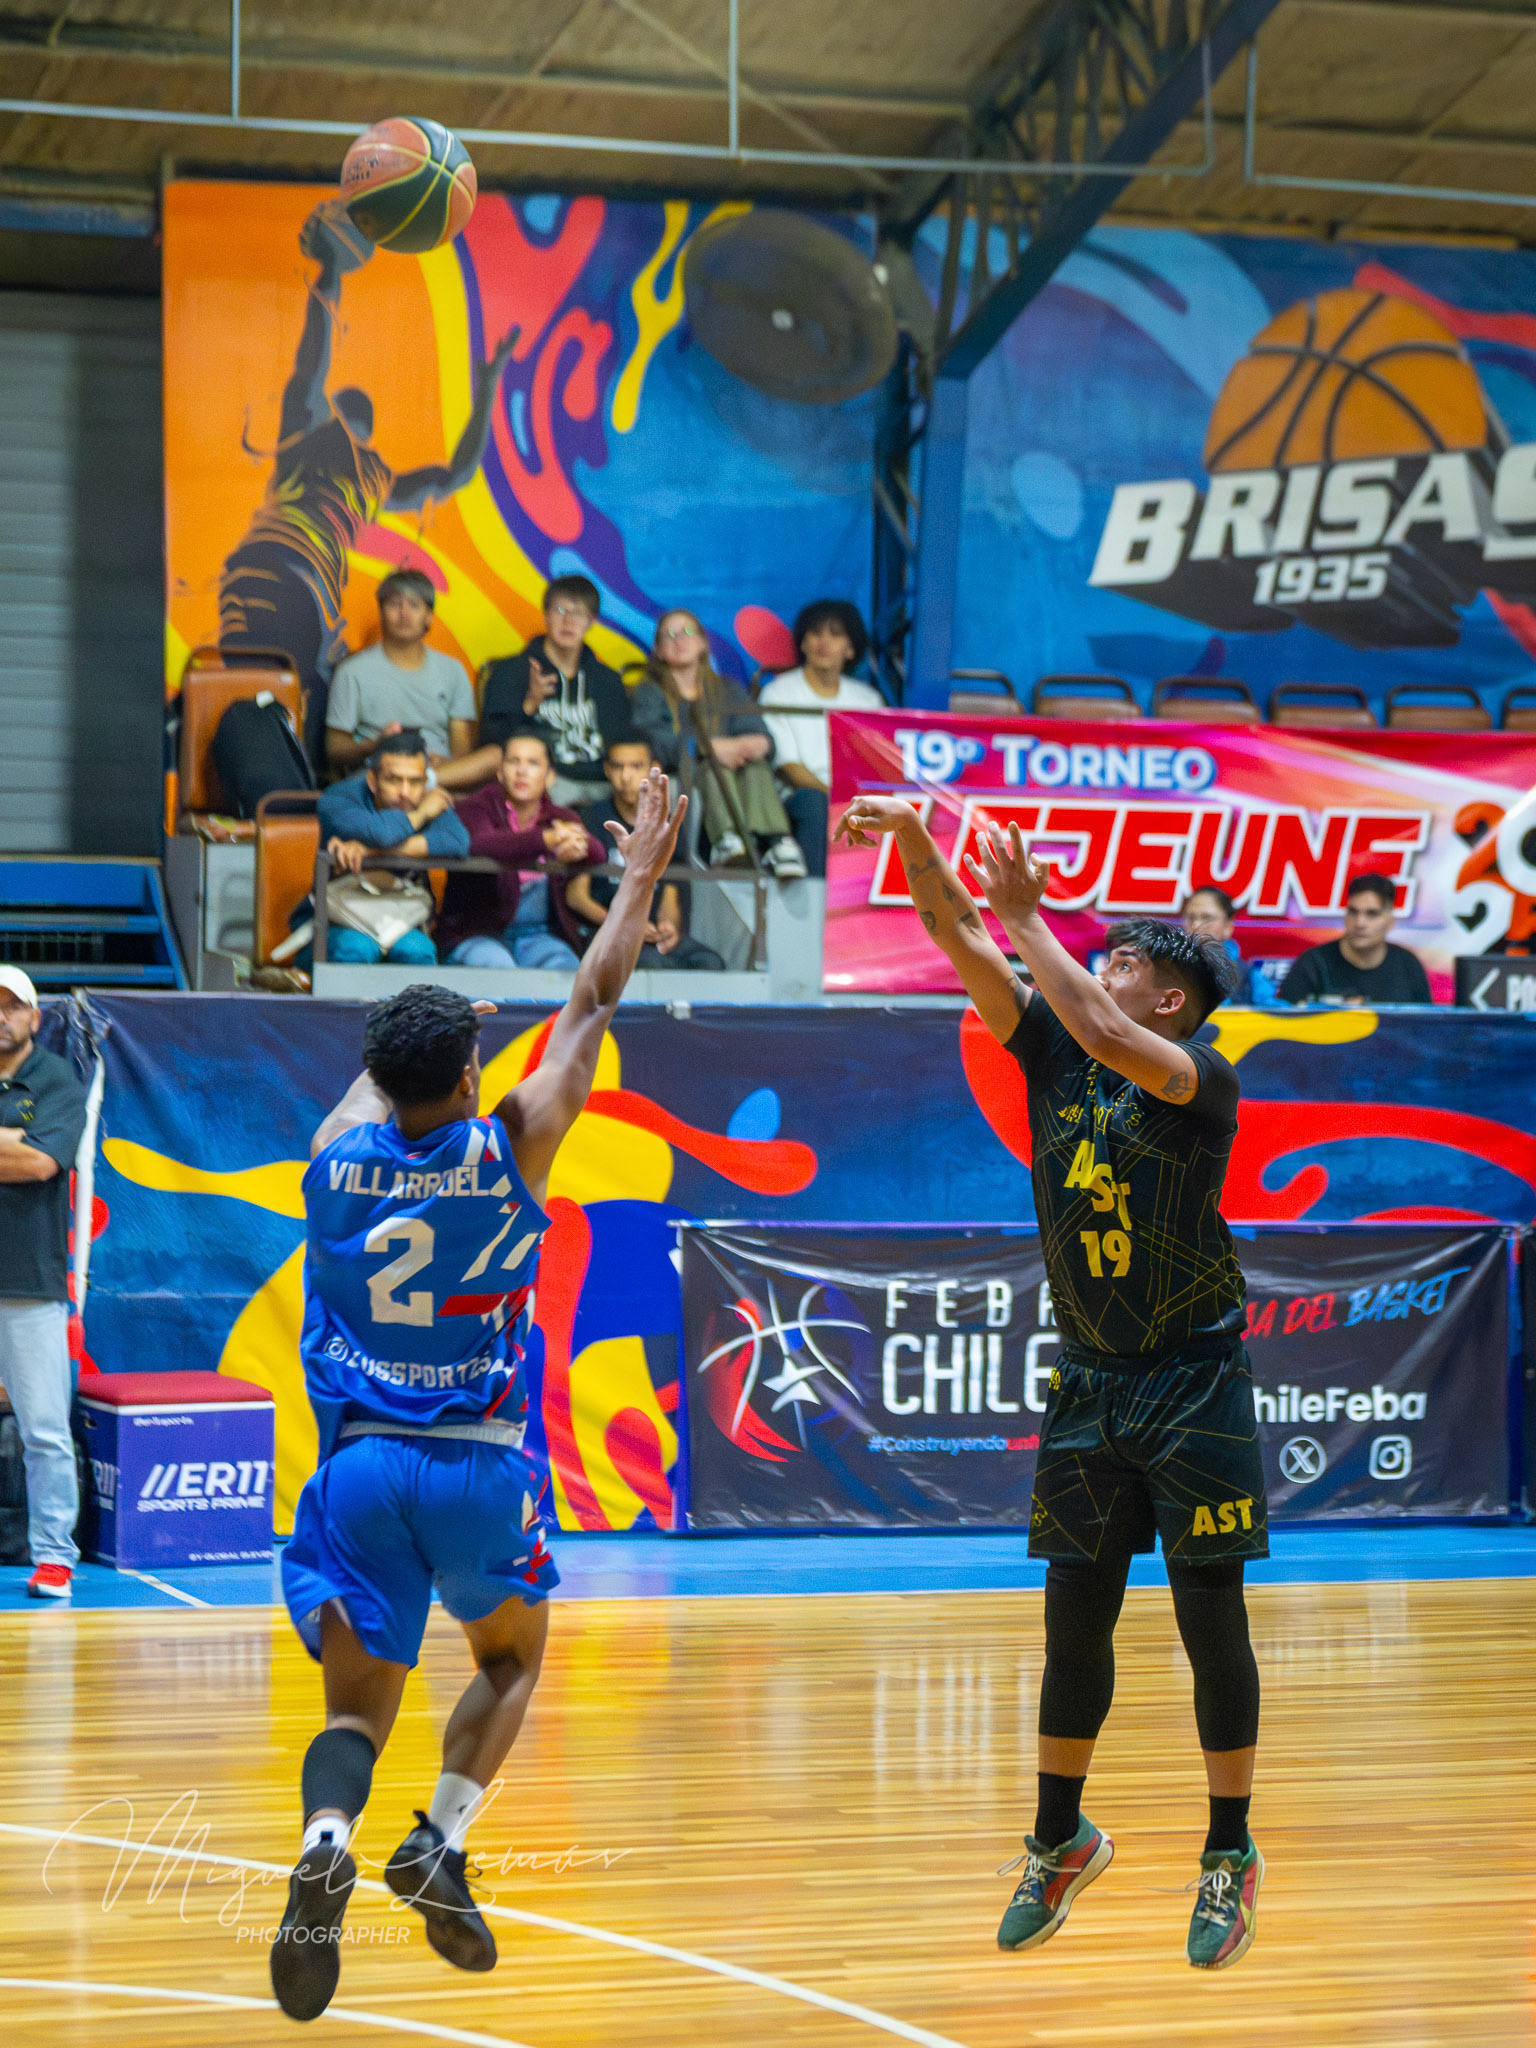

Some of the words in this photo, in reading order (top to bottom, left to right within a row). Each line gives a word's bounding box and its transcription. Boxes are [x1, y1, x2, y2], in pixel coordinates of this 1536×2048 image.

[1253, 552, 1392, 605] 1935
[992, 733, 1217, 792] TORNEO
[328, 1159, 492, 1200] VILLARROEL
[1063, 1140, 1133, 1231] AST
[364, 1216, 435, 1328] 2
[1080, 1229, 1133, 1278] 19
[1283, 1293, 1338, 1335] DEL
[1343, 1266, 1471, 1327] BASKET
[882, 1332, 1062, 1416] CHILE
[1252, 1384, 1428, 1424] hileFeba
[1192, 1498, 1254, 1536] AST
